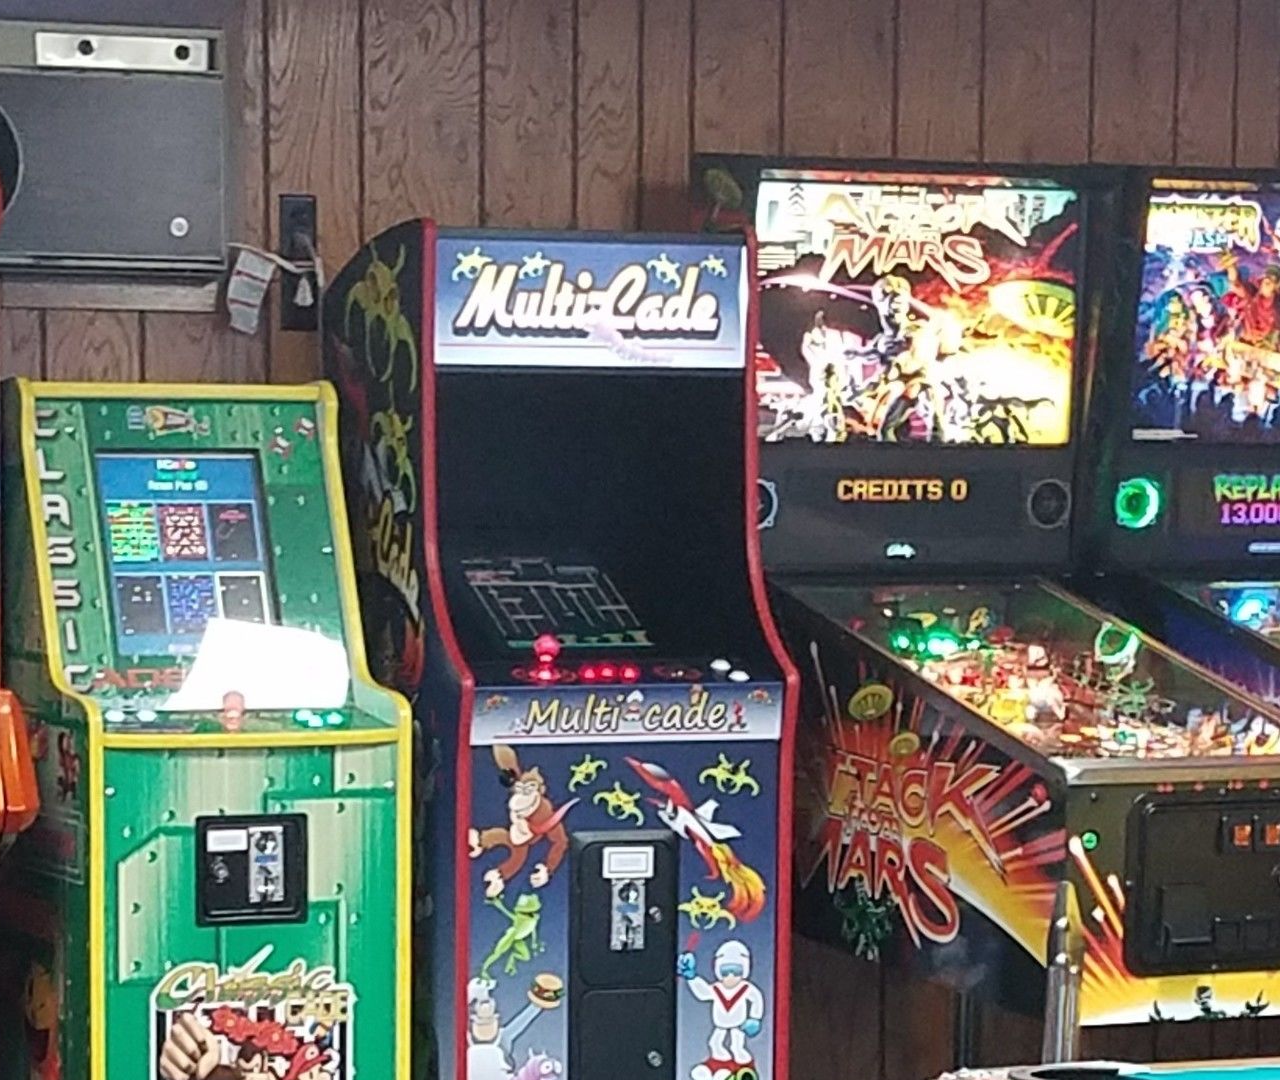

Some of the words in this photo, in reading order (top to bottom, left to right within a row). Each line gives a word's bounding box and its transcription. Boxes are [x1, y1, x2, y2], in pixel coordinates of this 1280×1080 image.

[818, 230, 992, 294] MARS
[836, 478, 945, 501] CREDITS
[950, 478, 969, 501] 0
